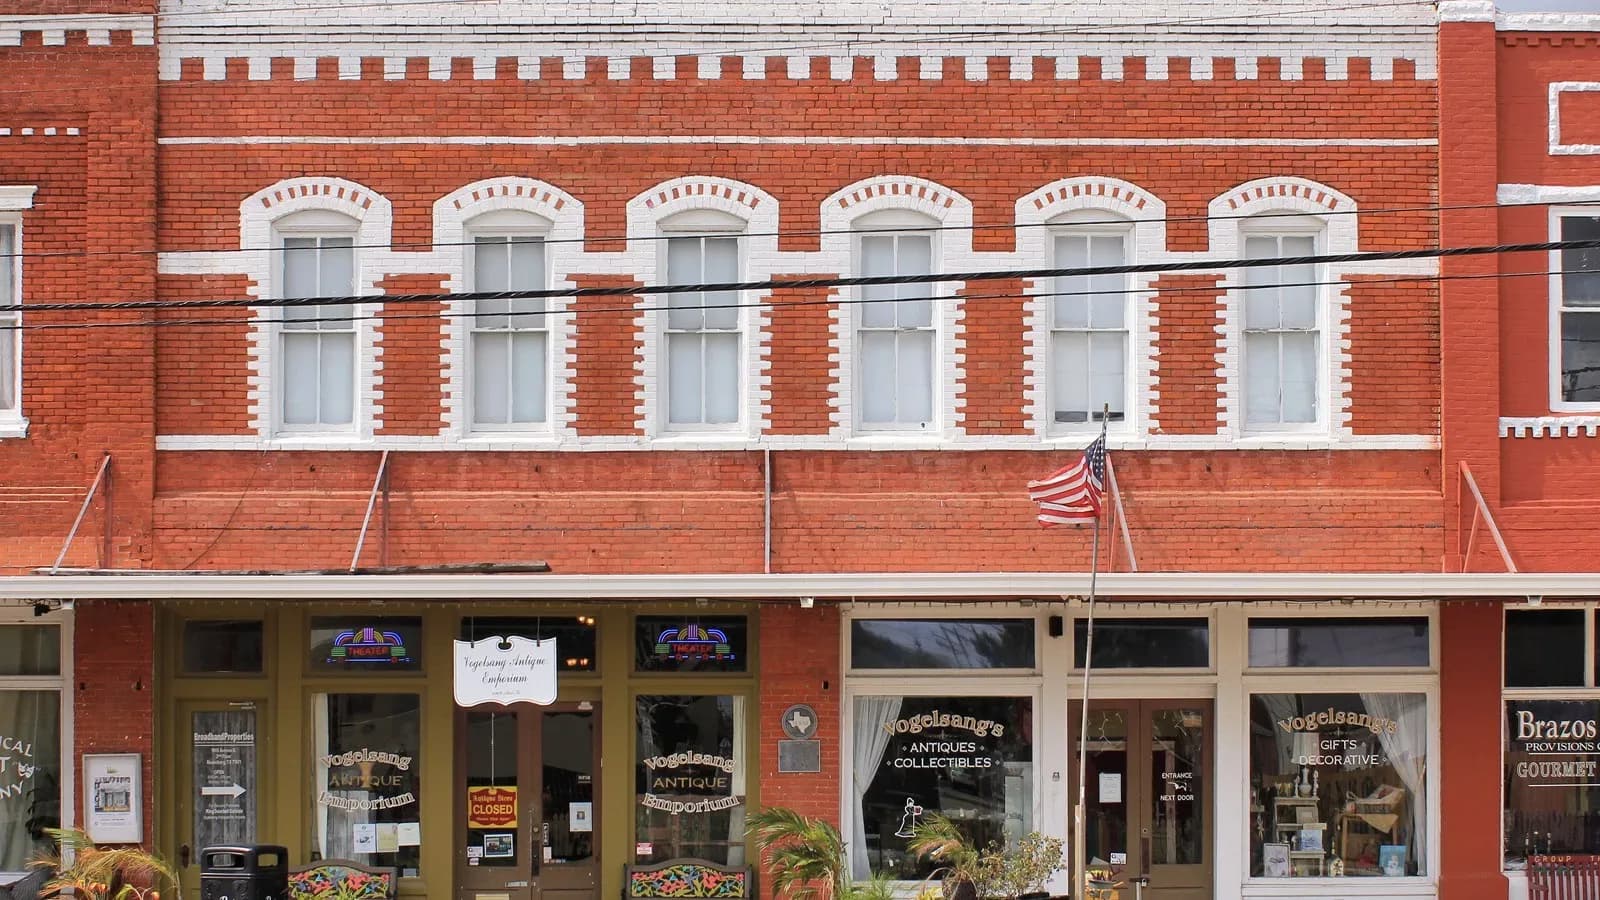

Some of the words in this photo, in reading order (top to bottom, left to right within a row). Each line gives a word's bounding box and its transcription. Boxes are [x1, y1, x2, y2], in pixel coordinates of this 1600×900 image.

[347, 647, 389, 656] THEATER
[671, 644, 714, 653] THEATER
[464, 655, 506, 672] Vogelsang
[509, 654, 547, 670] Antique
[482, 671, 527, 688] Emporium
[882, 709, 1005, 737] Vogelsang's
[1278, 707, 1397, 734] Vogelsang's
[1516, 710, 1597, 739] Brazos
[909, 742, 976, 754] ANTIQUES
[1320, 739, 1357, 750] GIFTS
[1525, 742, 1594, 752] PROVISIONS
[320, 748, 412, 771] Vogelsang
[643, 750, 737, 773] Vogelsang
[894, 758, 992, 768] COLLECTIBLES
[1299, 754, 1380, 765] DECORATIVE
[1516, 761, 1597, 778] GOURMET
[329, 774, 404, 788] ANTQUE
[653, 777, 728, 789] ANTIQUE
[319, 791, 415, 813] Emporium
[642, 792, 740, 815] Emporium
[472, 804, 513, 815] CLOSED
[1534, 855, 1572, 863] GROUP
